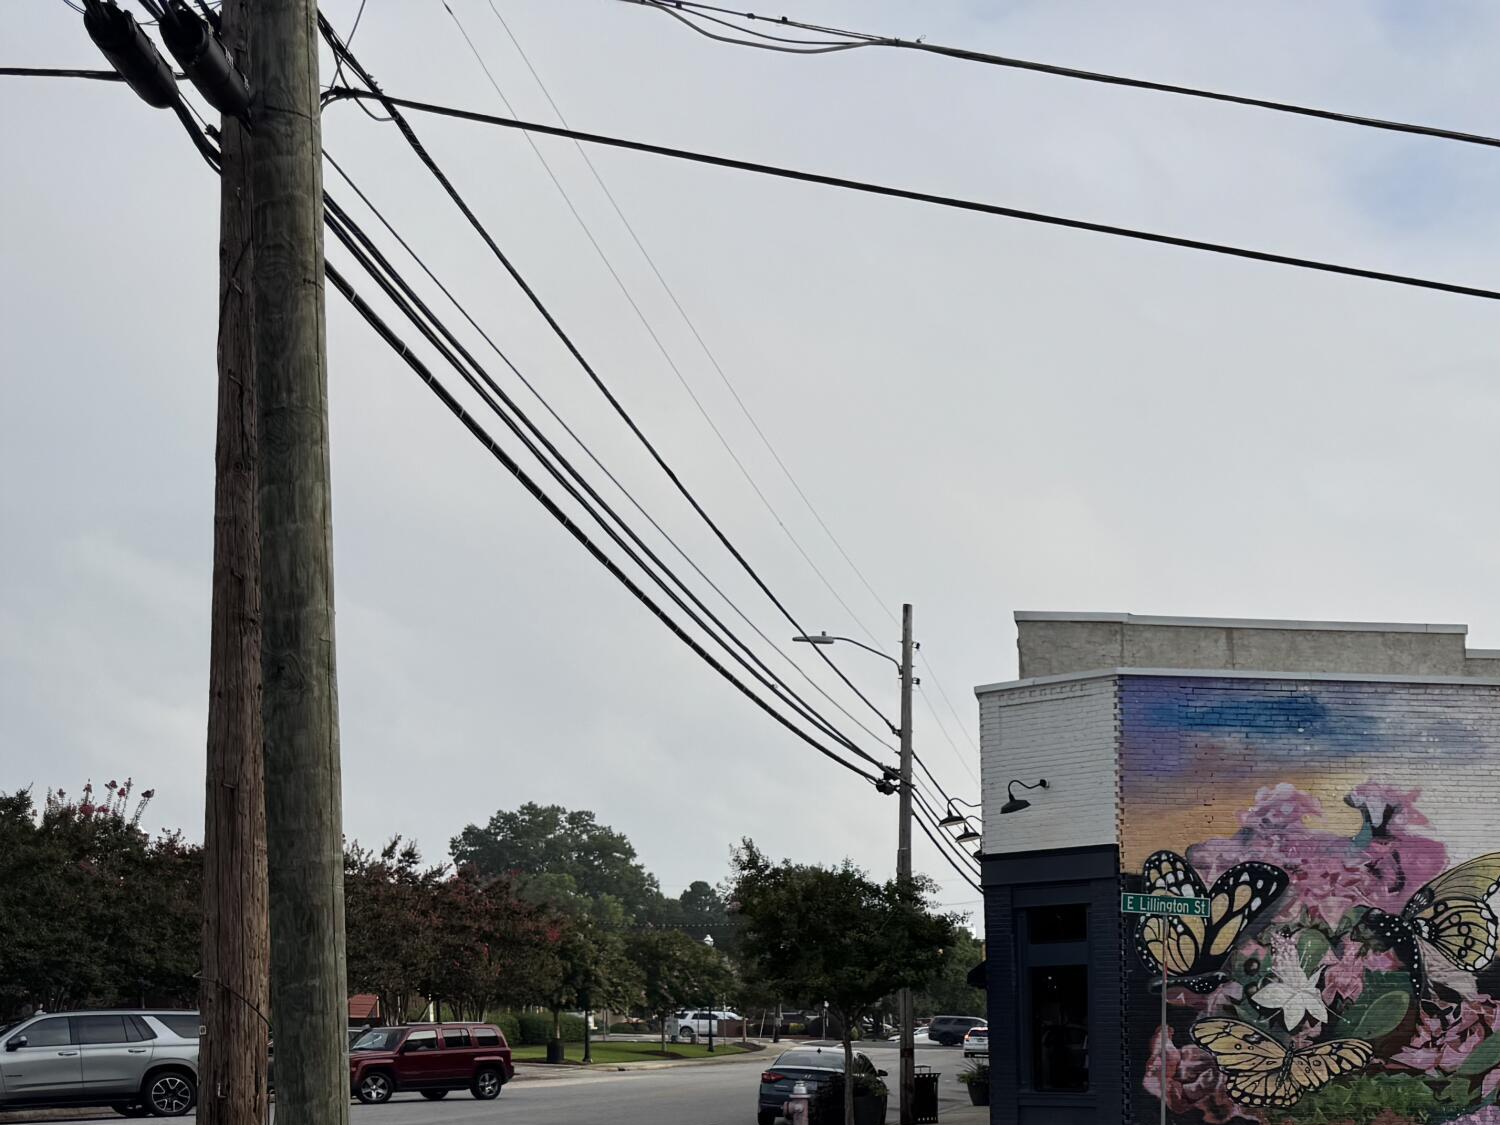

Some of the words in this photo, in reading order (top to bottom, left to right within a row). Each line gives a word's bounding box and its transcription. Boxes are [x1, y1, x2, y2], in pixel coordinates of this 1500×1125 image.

[1127, 896, 1134, 910] E
[1140, 897, 1189, 914] Lillington
[1194, 900, 1206, 915] St
